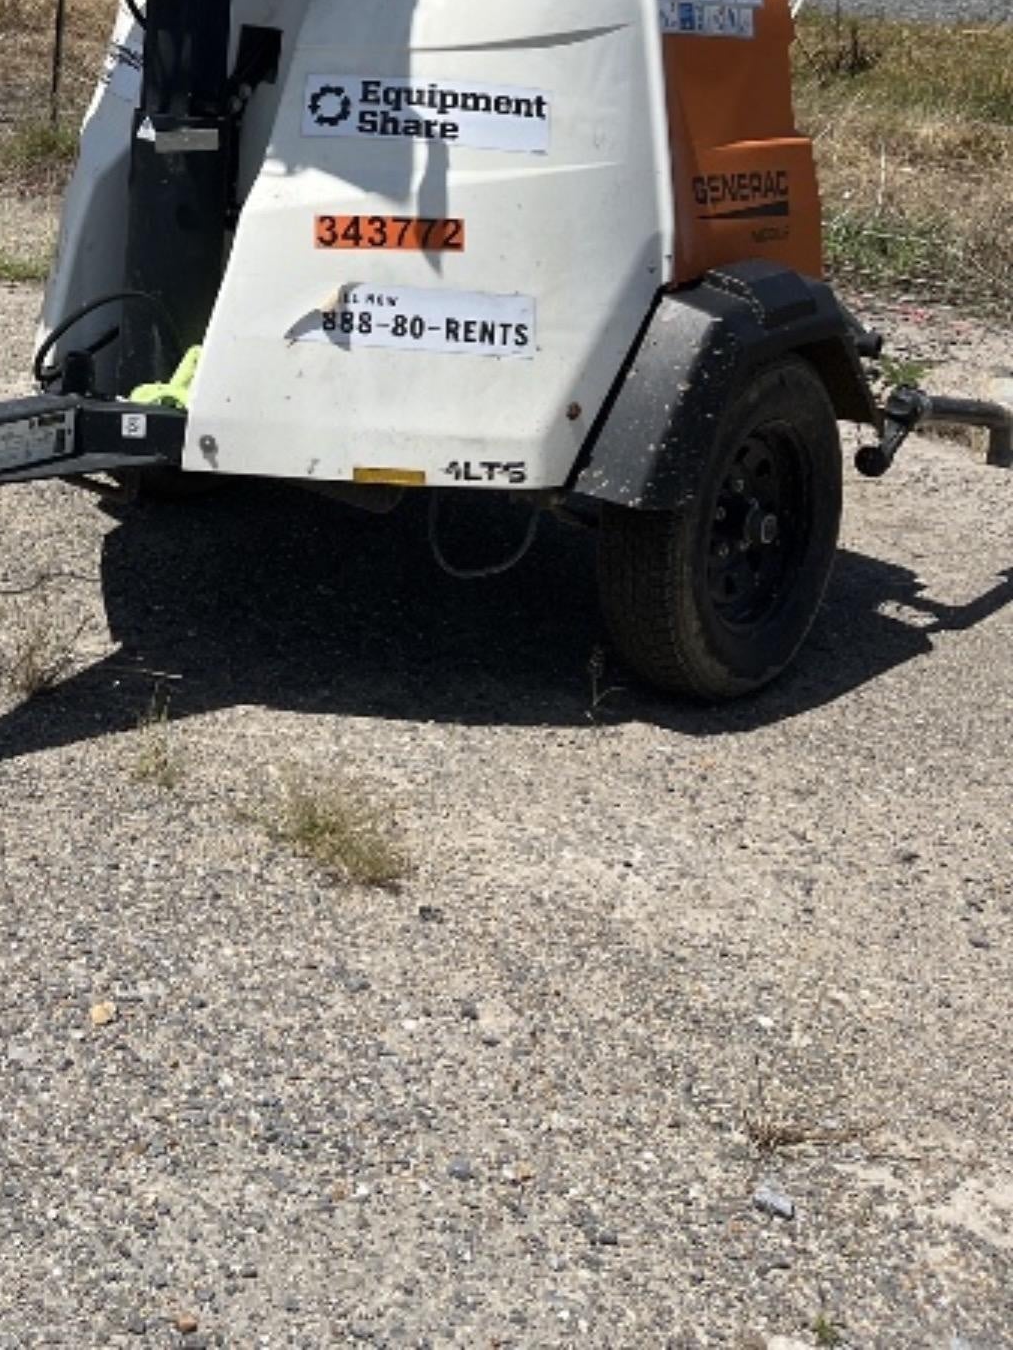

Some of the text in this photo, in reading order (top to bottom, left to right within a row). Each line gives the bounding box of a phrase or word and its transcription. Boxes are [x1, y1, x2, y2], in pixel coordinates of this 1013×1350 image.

[358, 80, 548, 118] Equipment
[356, 110, 460, 140] Share
[692, 170, 788, 205] GENERAC
[317, 215, 463, 248] 343772
[322, 311, 529, 347] 888-80-RENTS
